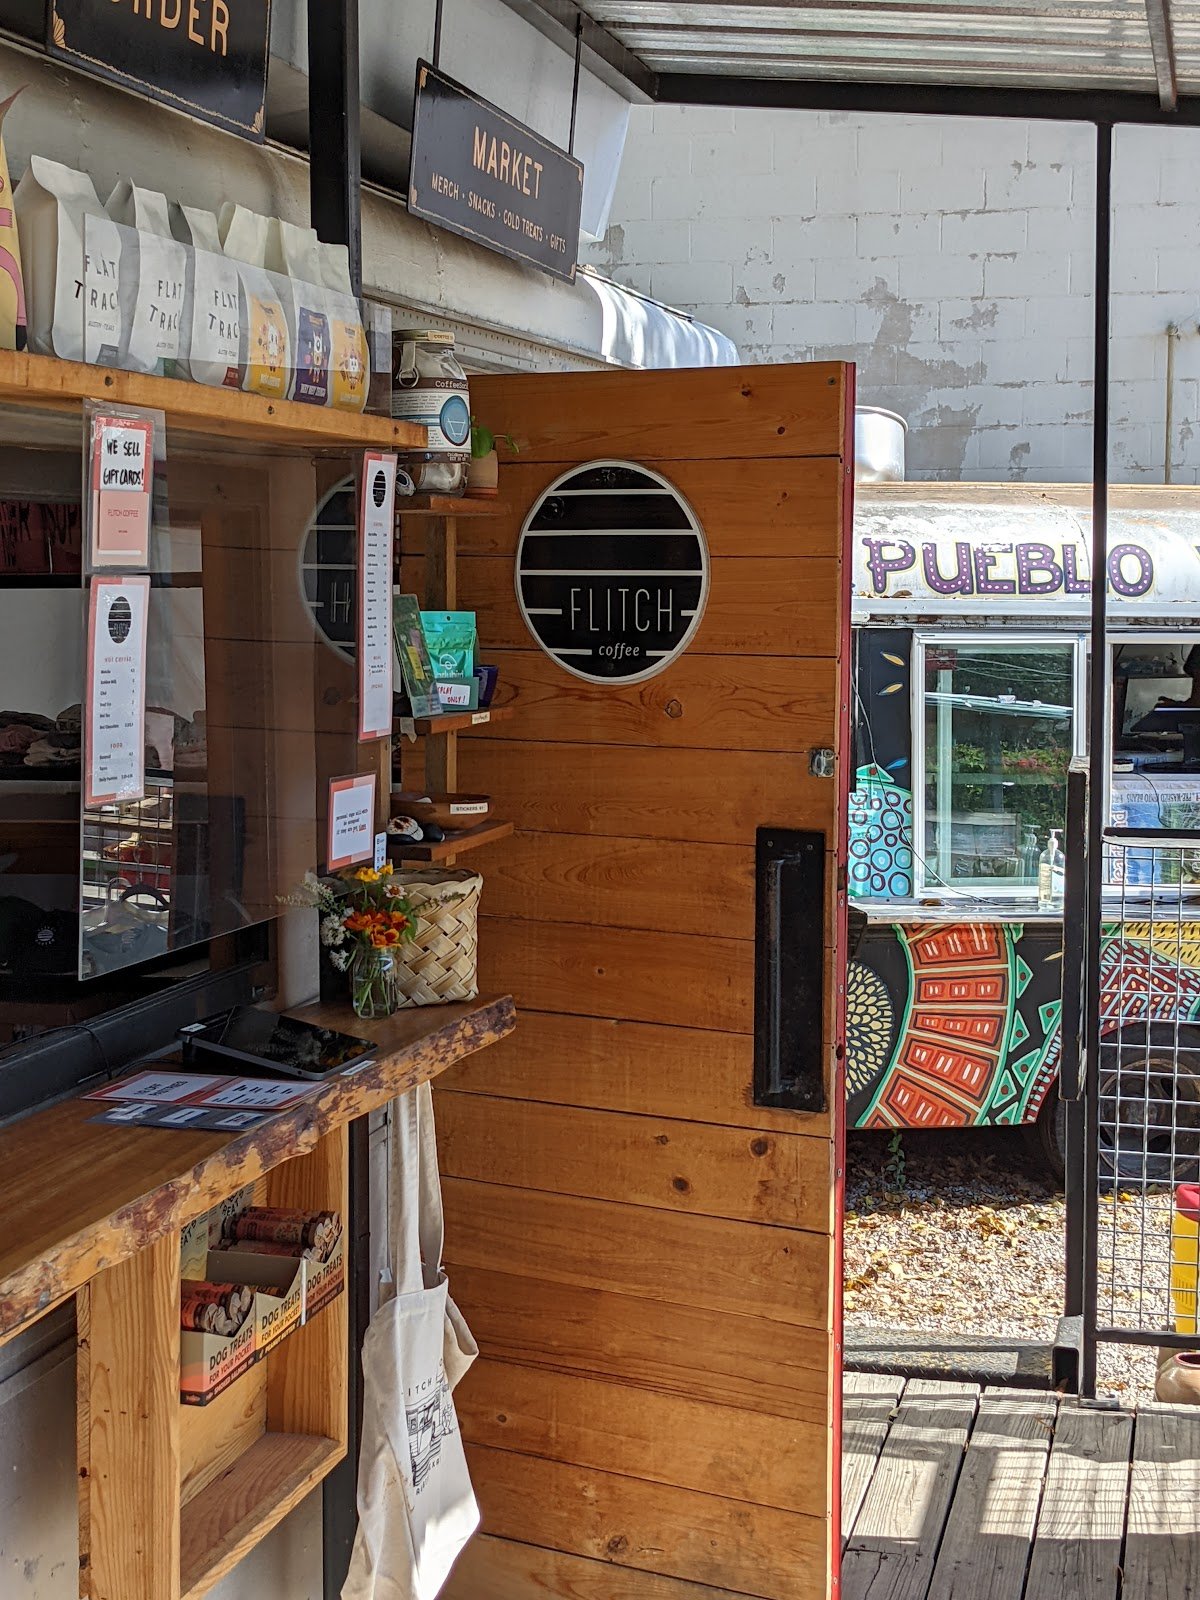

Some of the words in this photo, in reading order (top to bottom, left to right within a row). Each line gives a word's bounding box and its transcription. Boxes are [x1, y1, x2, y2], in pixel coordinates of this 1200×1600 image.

[111, 0, 230, 57] DER
[473, 125, 543, 200] MARKET
[431, 172, 460, 201] MERCH
[468, 190, 496, 219] SNACKS
[503, 209, 520, 231] COLD
[521, 218, 544, 242] TREATS
[549, 233, 566, 254] GIFTS
[73, 280, 119, 312] TRAC
[157, 279, 182, 301] FLAT
[213, 290, 237, 310] FLAT
[149, 304, 181, 332] TRAC
[106, 438, 118, 456] WE
[123, 441, 141, 457] SELL
[102, 469, 120, 486] GIFT
[119, 468, 145, 487] CARDS!
[862, 538, 1154, 597] PUEBLO
[570, 588, 673, 632] FLITCH
[598, 642, 640, 659] coffee
[307, 1271, 321, 1293] DOG
[323, 1253, 343, 1279] TREATS
[261, 1307, 279, 1330] DOG
[280, 1288, 301, 1317] TREATS
[261, 1329, 273, 1343] FOR
[272, 1319, 285, 1335] YOUR
[284, 1304, 300, 1324] POCKET
[209, 1346, 228, 1371] DOG
[229, 1327, 253, 1356] TREATS
[209, 1369, 220, 1385] FOR
[220, 1358, 234, 1375] YOUR
[234, 1342, 252, 1363] POCKET
